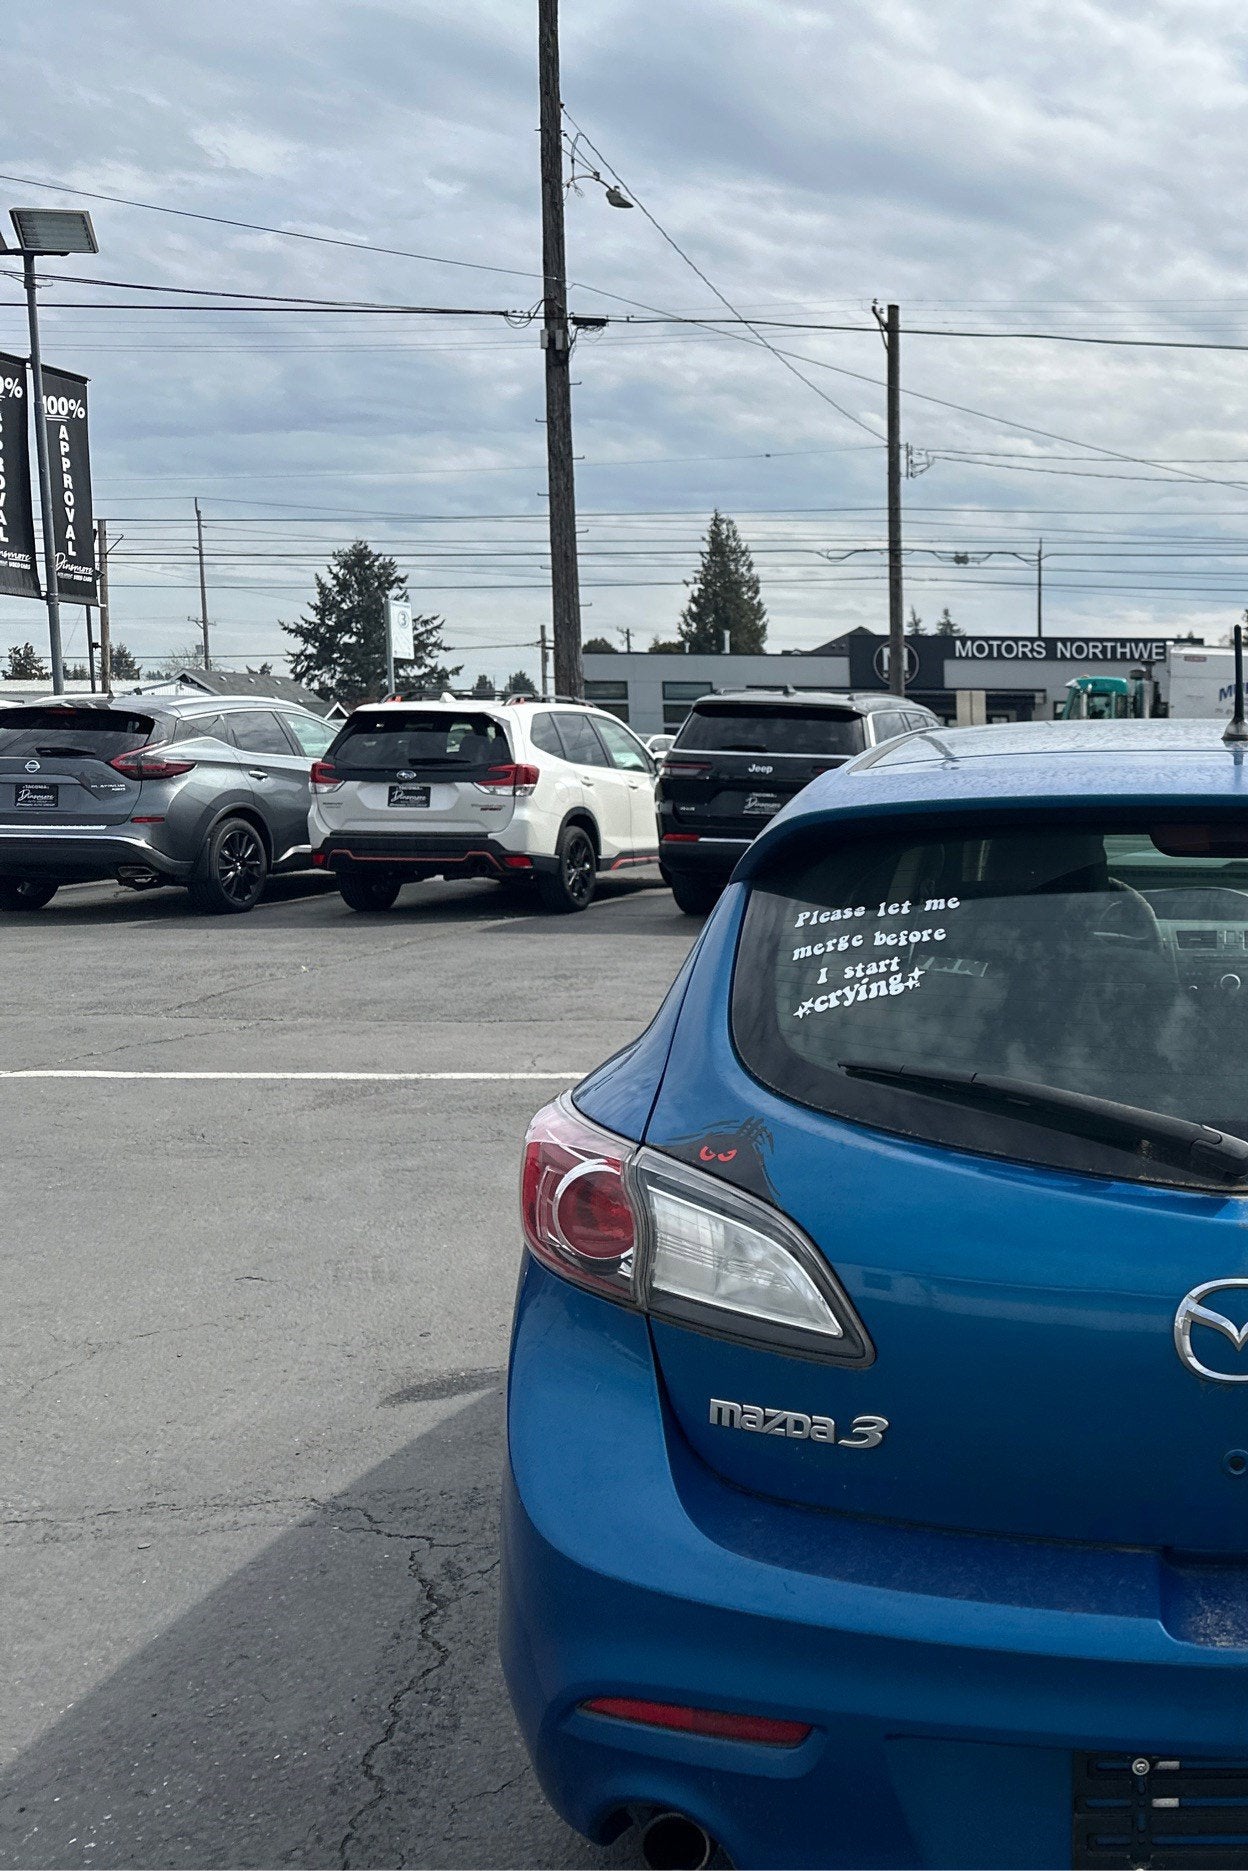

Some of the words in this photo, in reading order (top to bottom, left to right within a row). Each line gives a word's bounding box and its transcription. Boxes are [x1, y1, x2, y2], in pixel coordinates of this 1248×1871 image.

[42, 395, 86, 419] 100%
[57, 424, 77, 557] APPROVAL
[54, 552, 94, 575] Dinsmore
[955, 640, 1047, 659] MOTORS
[748, 763, 773, 774] Jeep
[794, 905, 866, 928] Please
[877, 900, 912, 917] let
[924, 896, 961, 912] me
[792, 934, 864, 961] merge
[873, 928, 947, 946] before
[816, 967, 828, 984] I
[843, 956, 901, 979] start
[813, 972, 906, 1013] crying
[837, 1415, 890, 1449] 3
